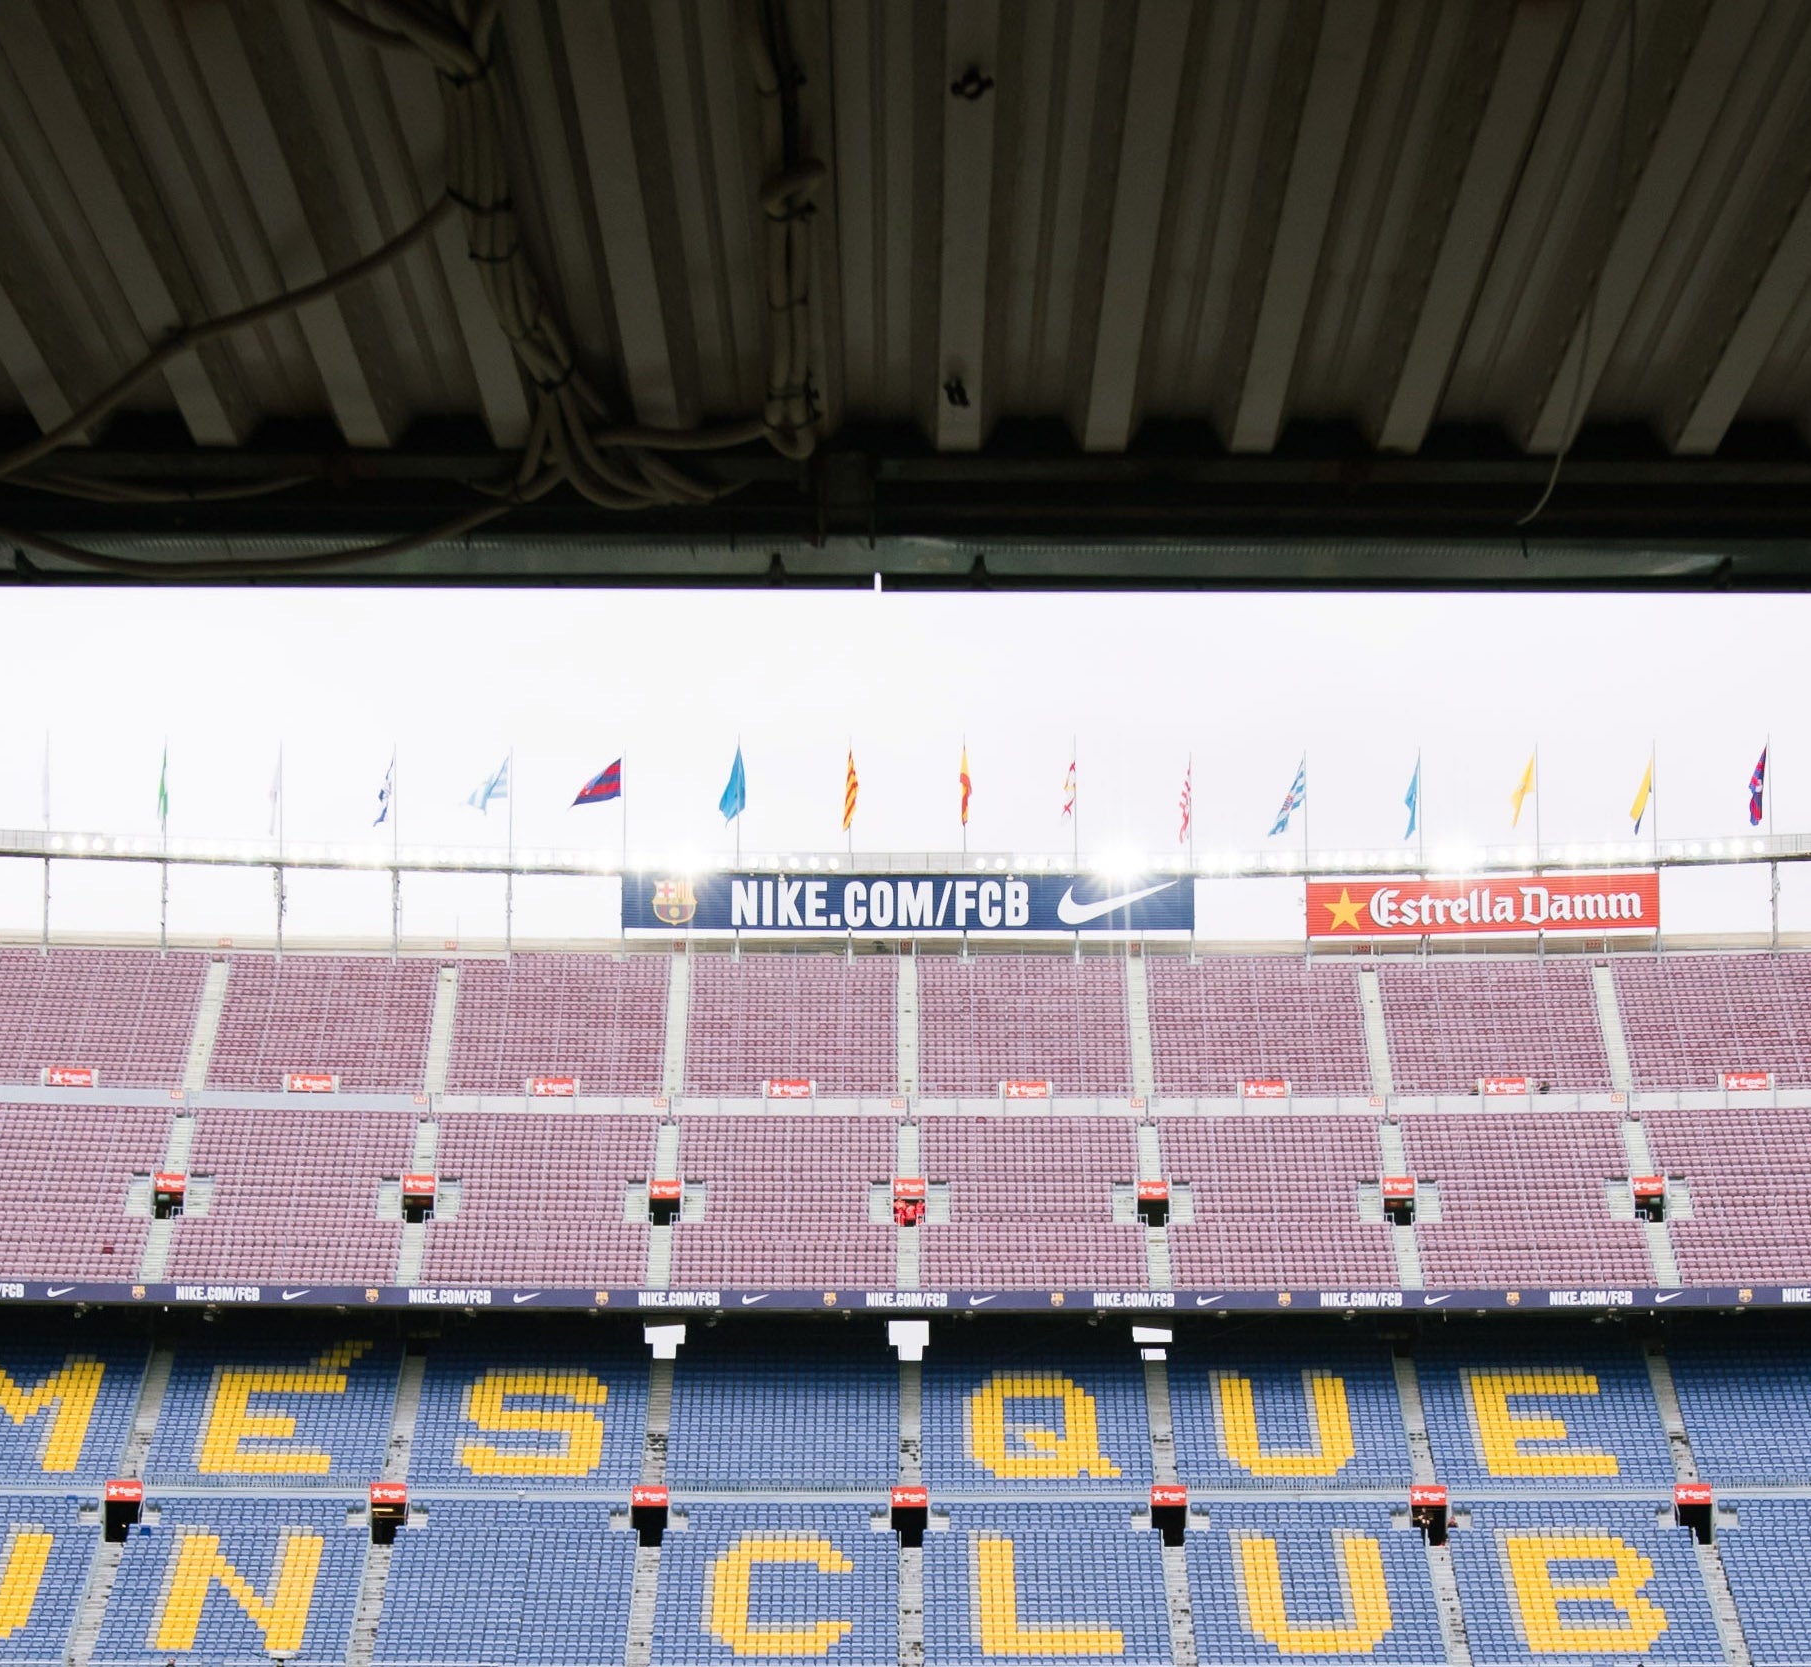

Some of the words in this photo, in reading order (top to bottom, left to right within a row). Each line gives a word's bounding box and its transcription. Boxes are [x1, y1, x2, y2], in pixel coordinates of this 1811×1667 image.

[732, 879, 1029, 928] NIKE.COM/FCB
[1370, 885, 1515, 926] Estrella
[1520, 885, 1644, 925] Damm
[176, 1286, 259, 1301] NIKE.COM/FCB
[409, 1289, 491, 1304] NIKE.COM/FCB
[639, 1292, 720, 1306] NIKE.COM/FCB
[866, 1293, 947, 1307] NIKE.COM/FCB
[1094, 1293, 1174, 1307] NIKE.COM/FCB
[1321, 1293, 1402, 1306] NIKE.COM/FCB
[1550, 1291, 1632, 1305] NIKE.COM/FCB
[970, 1374, 1620, 1477] QUE
[712, 1535, 1668, 1655] CLUB
